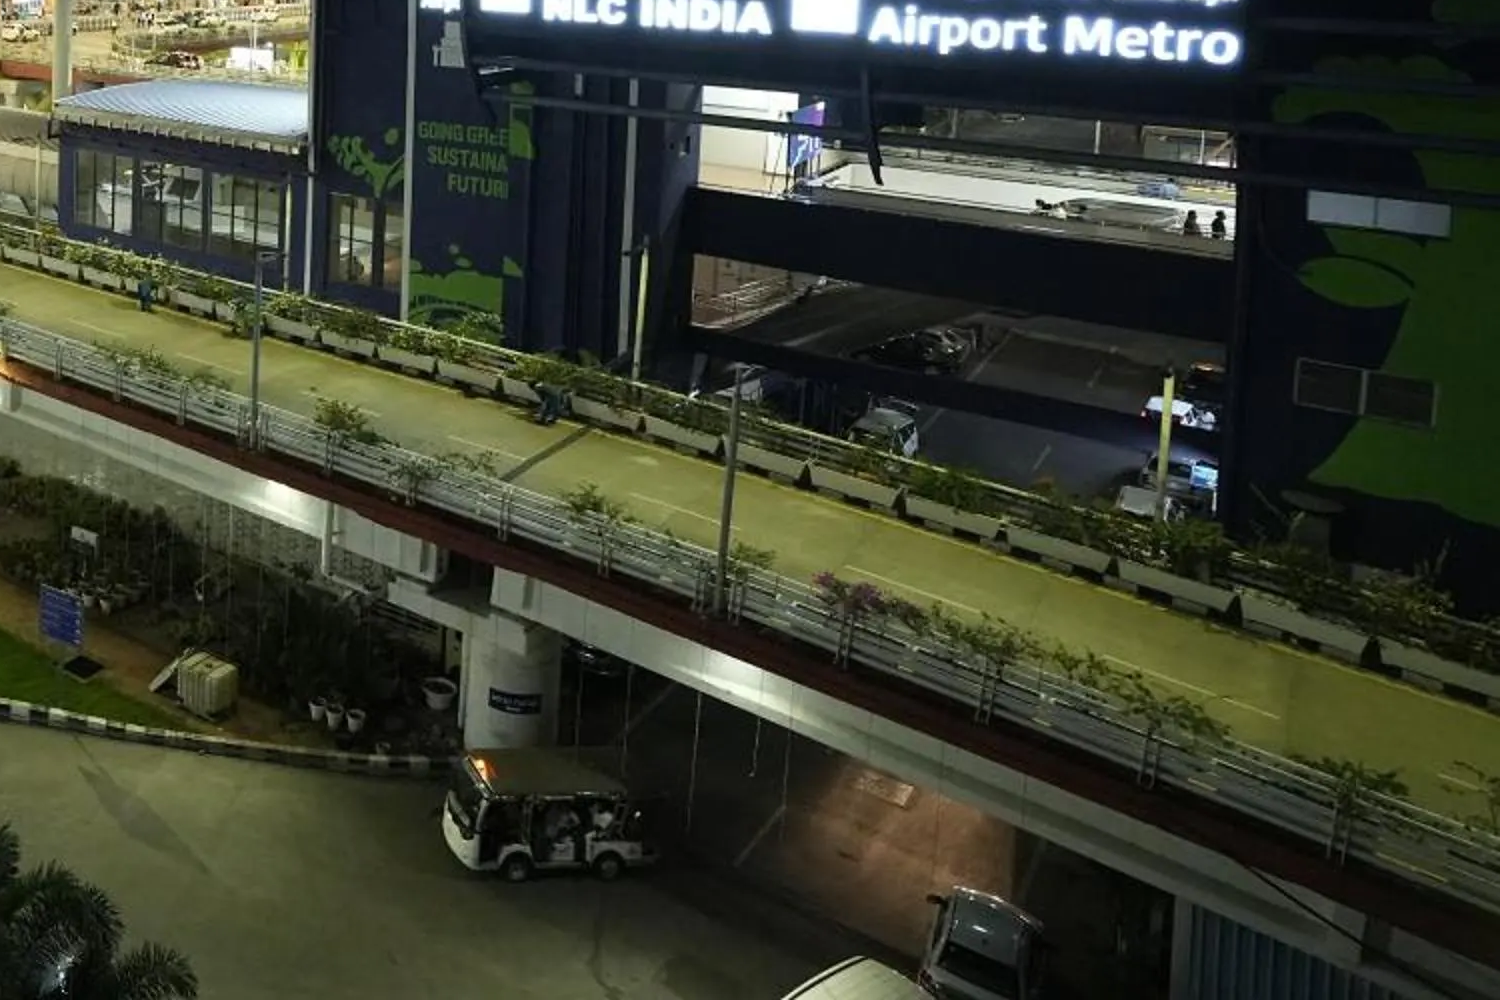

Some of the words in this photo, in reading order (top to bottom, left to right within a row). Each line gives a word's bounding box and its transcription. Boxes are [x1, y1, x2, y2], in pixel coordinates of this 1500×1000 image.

[867, 4, 1047, 55] Airport
[1063, 15, 1240, 65] Metro
[418, 121, 463, 142] GOING
[447, 173, 508, 199] FUTUR
